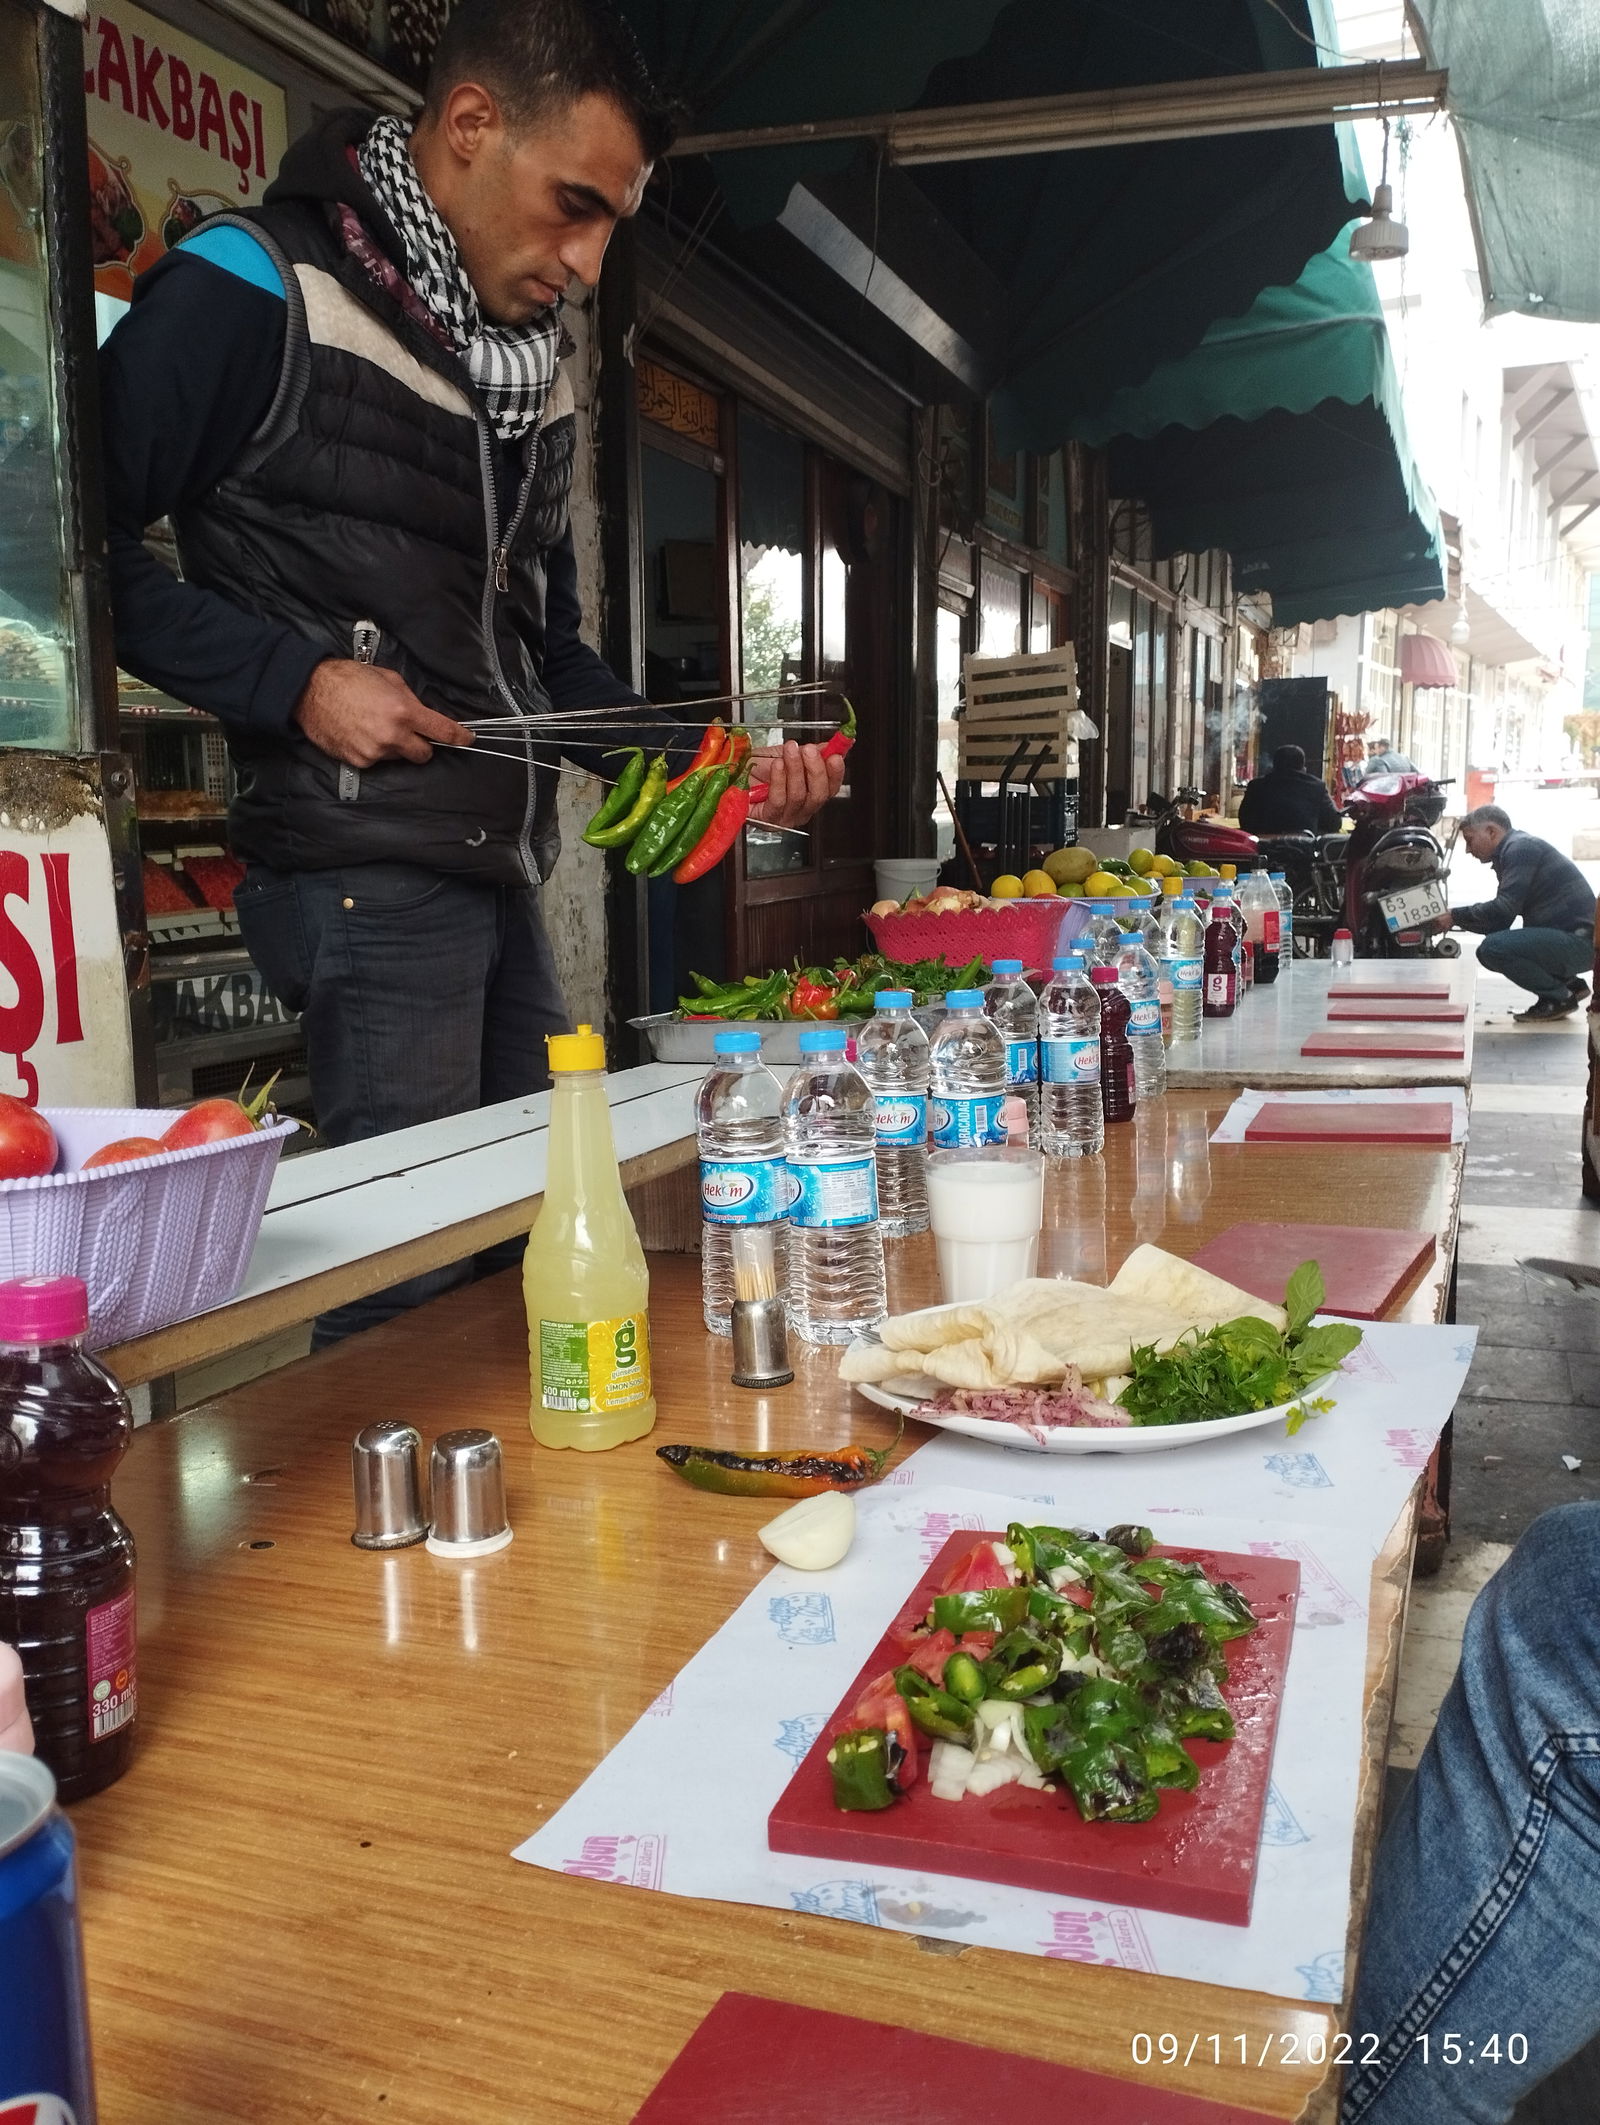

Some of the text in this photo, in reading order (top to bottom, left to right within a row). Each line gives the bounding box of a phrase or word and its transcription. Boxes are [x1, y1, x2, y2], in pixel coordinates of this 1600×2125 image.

[1386, 897, 1406, 913] 63
[1403, 901, 1442, 924] 1838
[543, 1386, 558, 1396] 500
[560, 1387, 571, 1398] ml
[93, 1694, 119, 1718] 330
[562, 1835, 620, 1879] Olsun
[638, 1840, 654, 1867] Ederiz
[1035, 1910, 1100, 1962] Olsun
[1117, 1918, 1137, 1949] Ederiz
